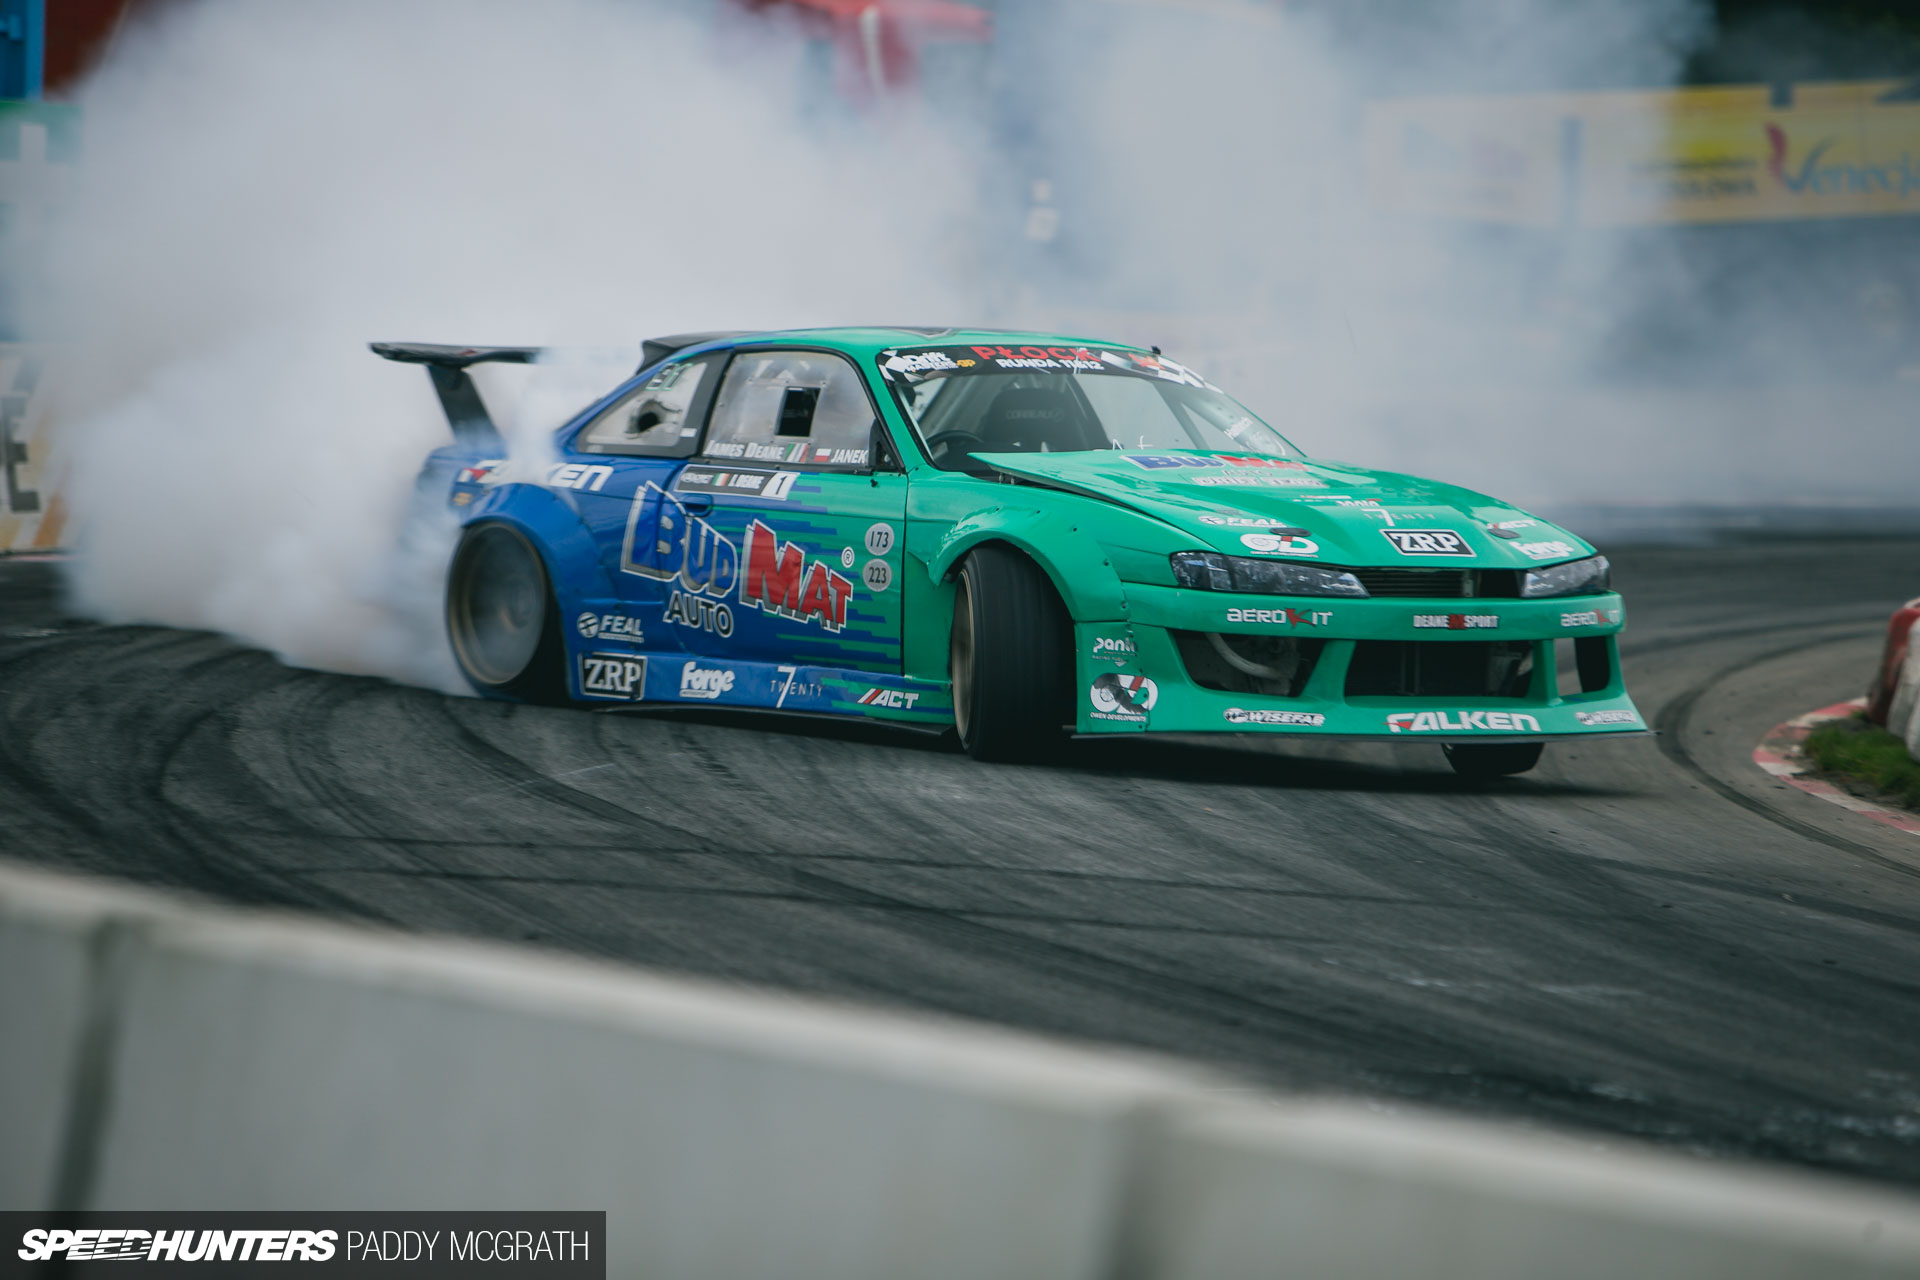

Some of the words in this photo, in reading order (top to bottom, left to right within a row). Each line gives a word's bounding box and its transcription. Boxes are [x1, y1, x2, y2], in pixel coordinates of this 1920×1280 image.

[996, 358, 1060, 368] RUNDA
[702, 440, 745, 457] JAMES
[744, 442, 785, 460] DEANE
[831, 448, 868, 464] JANEK
[870, 530, 889, 548] 173
[1389, 532, 1461, 552] ZRP
[620, 480, 738, 599] BUD
[739, 518, 854, 634] MAT
[868, 566, 887, 584] 223
[662, 590, 735, 638] AUTO
[600, 615, 644, 634] FEAL
[584, 659, 642, 695] ZRP
[1247, 710, 1325, 725] WISEFAB
[1383, 712, 1541, 732] FALKEN
